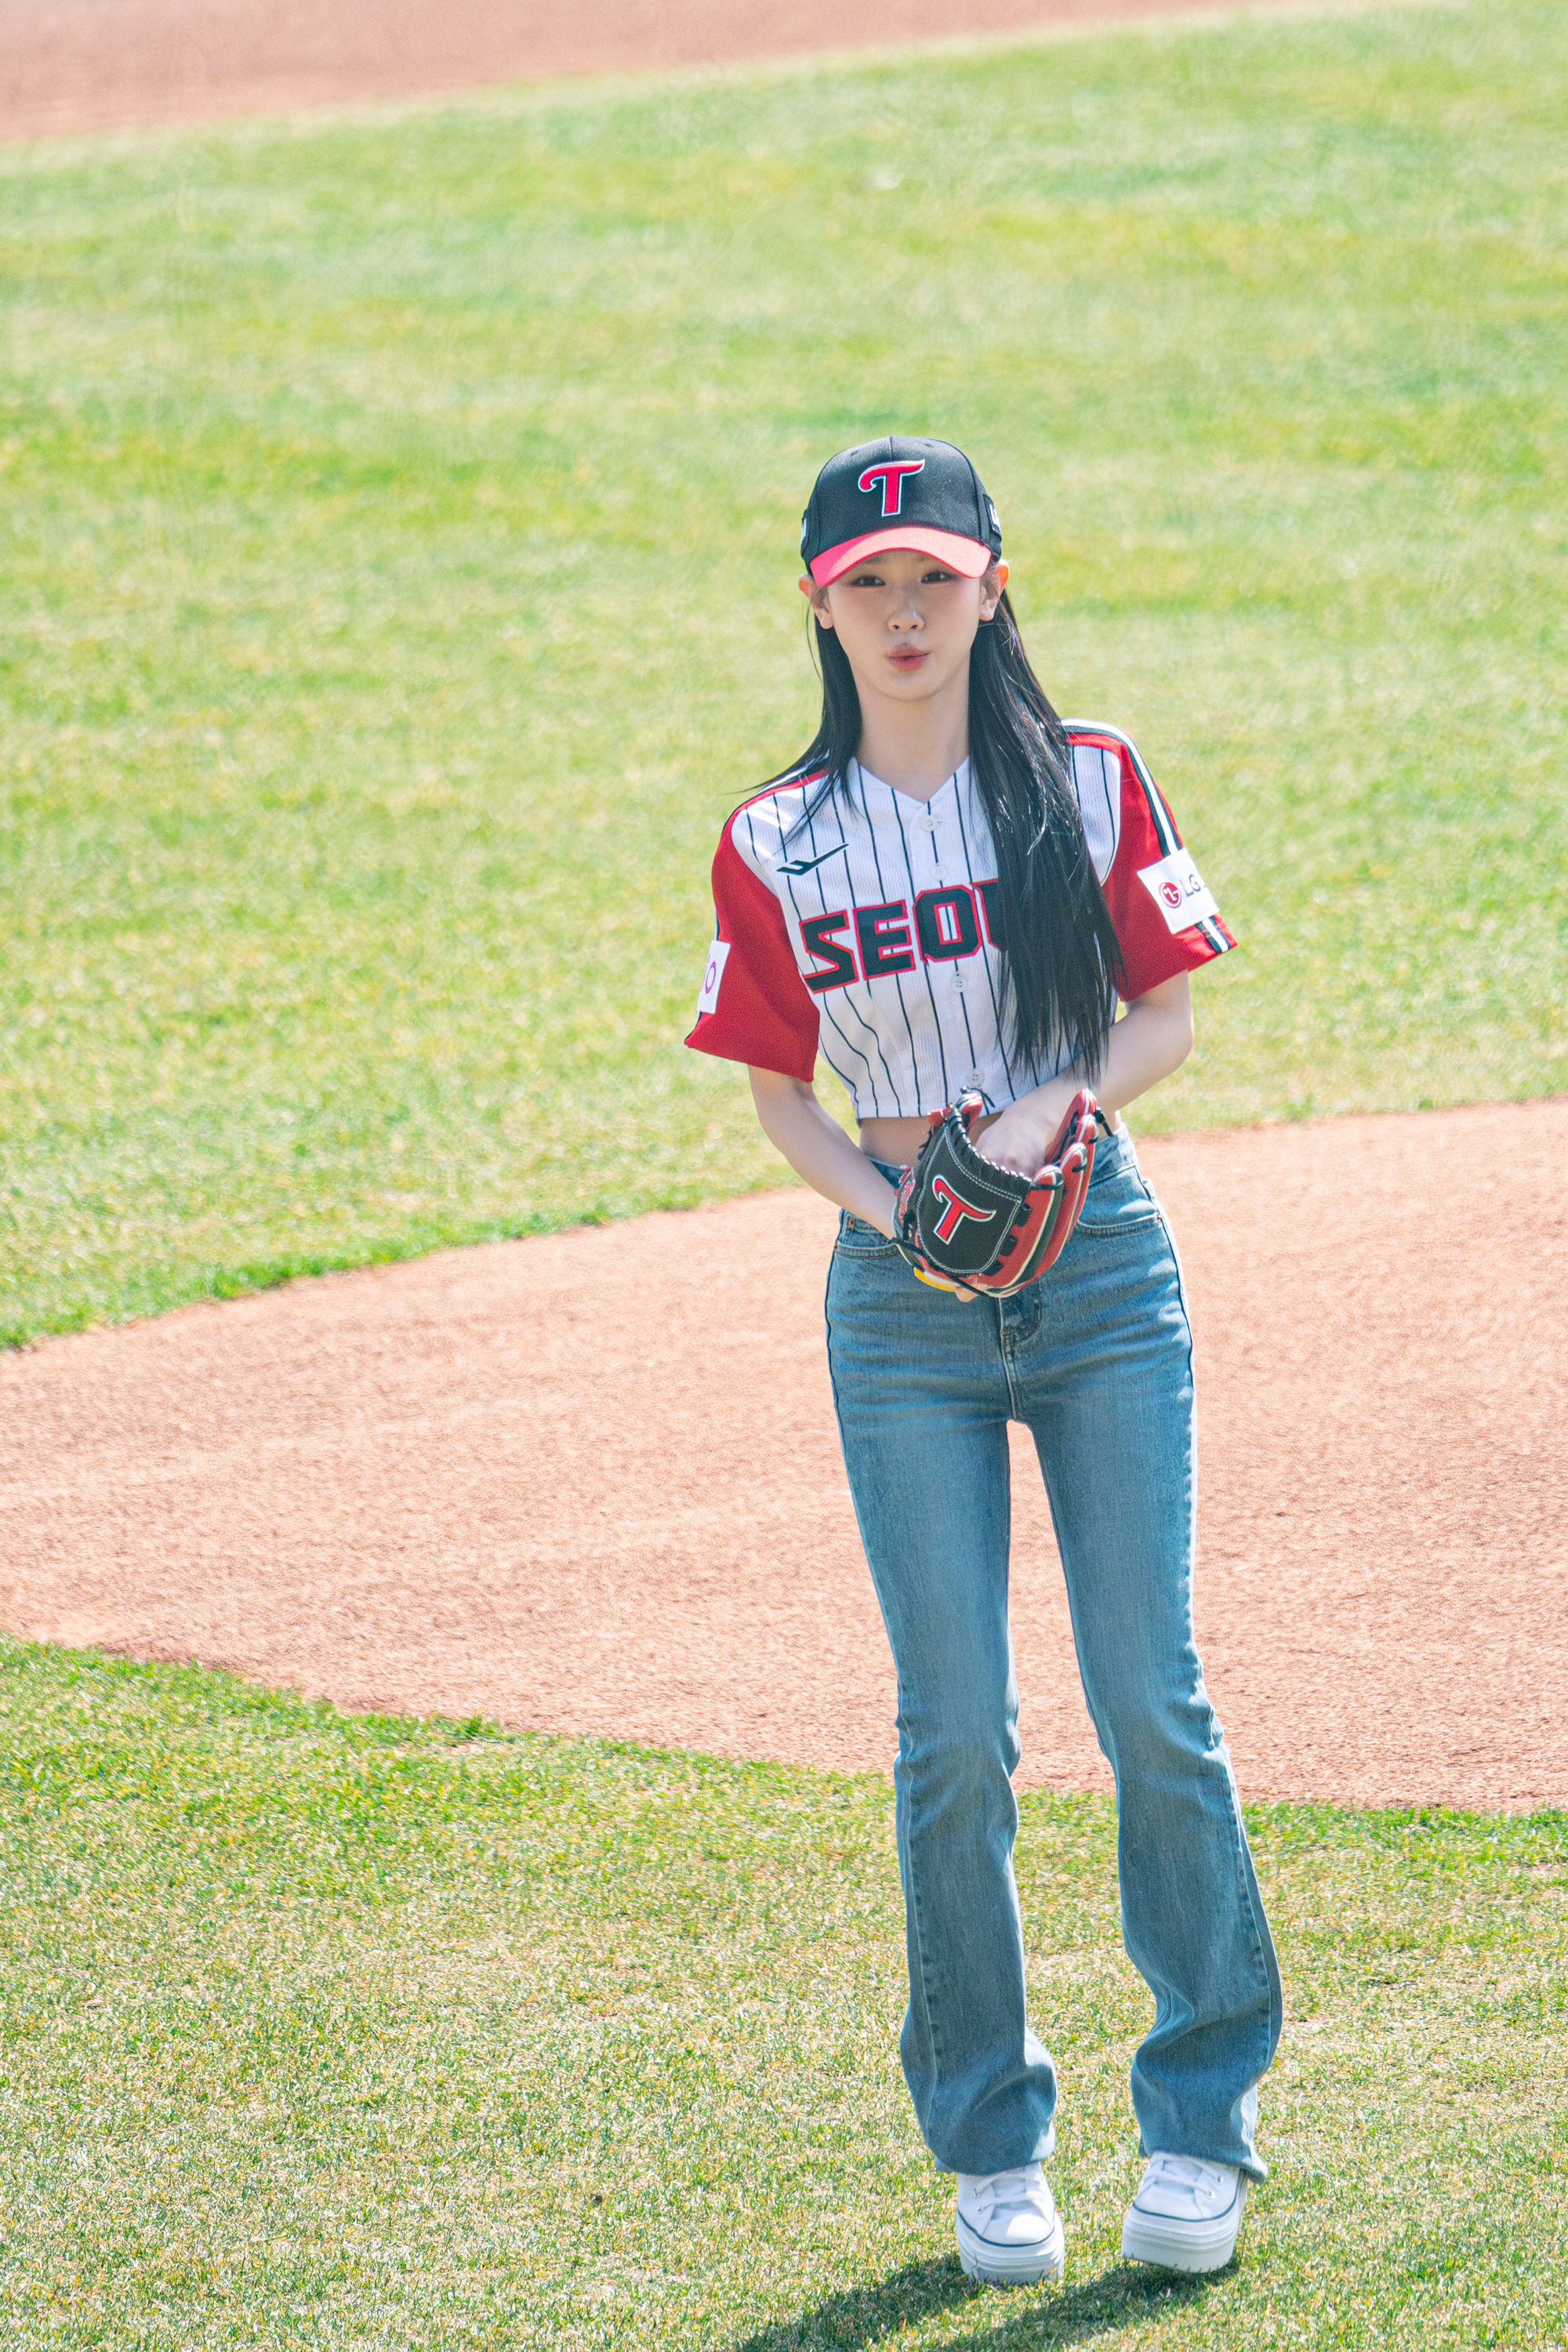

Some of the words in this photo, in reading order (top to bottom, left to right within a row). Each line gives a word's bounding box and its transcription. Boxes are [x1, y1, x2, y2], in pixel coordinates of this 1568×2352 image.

[858, 458, 925, 517] T
[1179, 873, 1201, 898] LG
[932, 1174, 996, 1245] T
